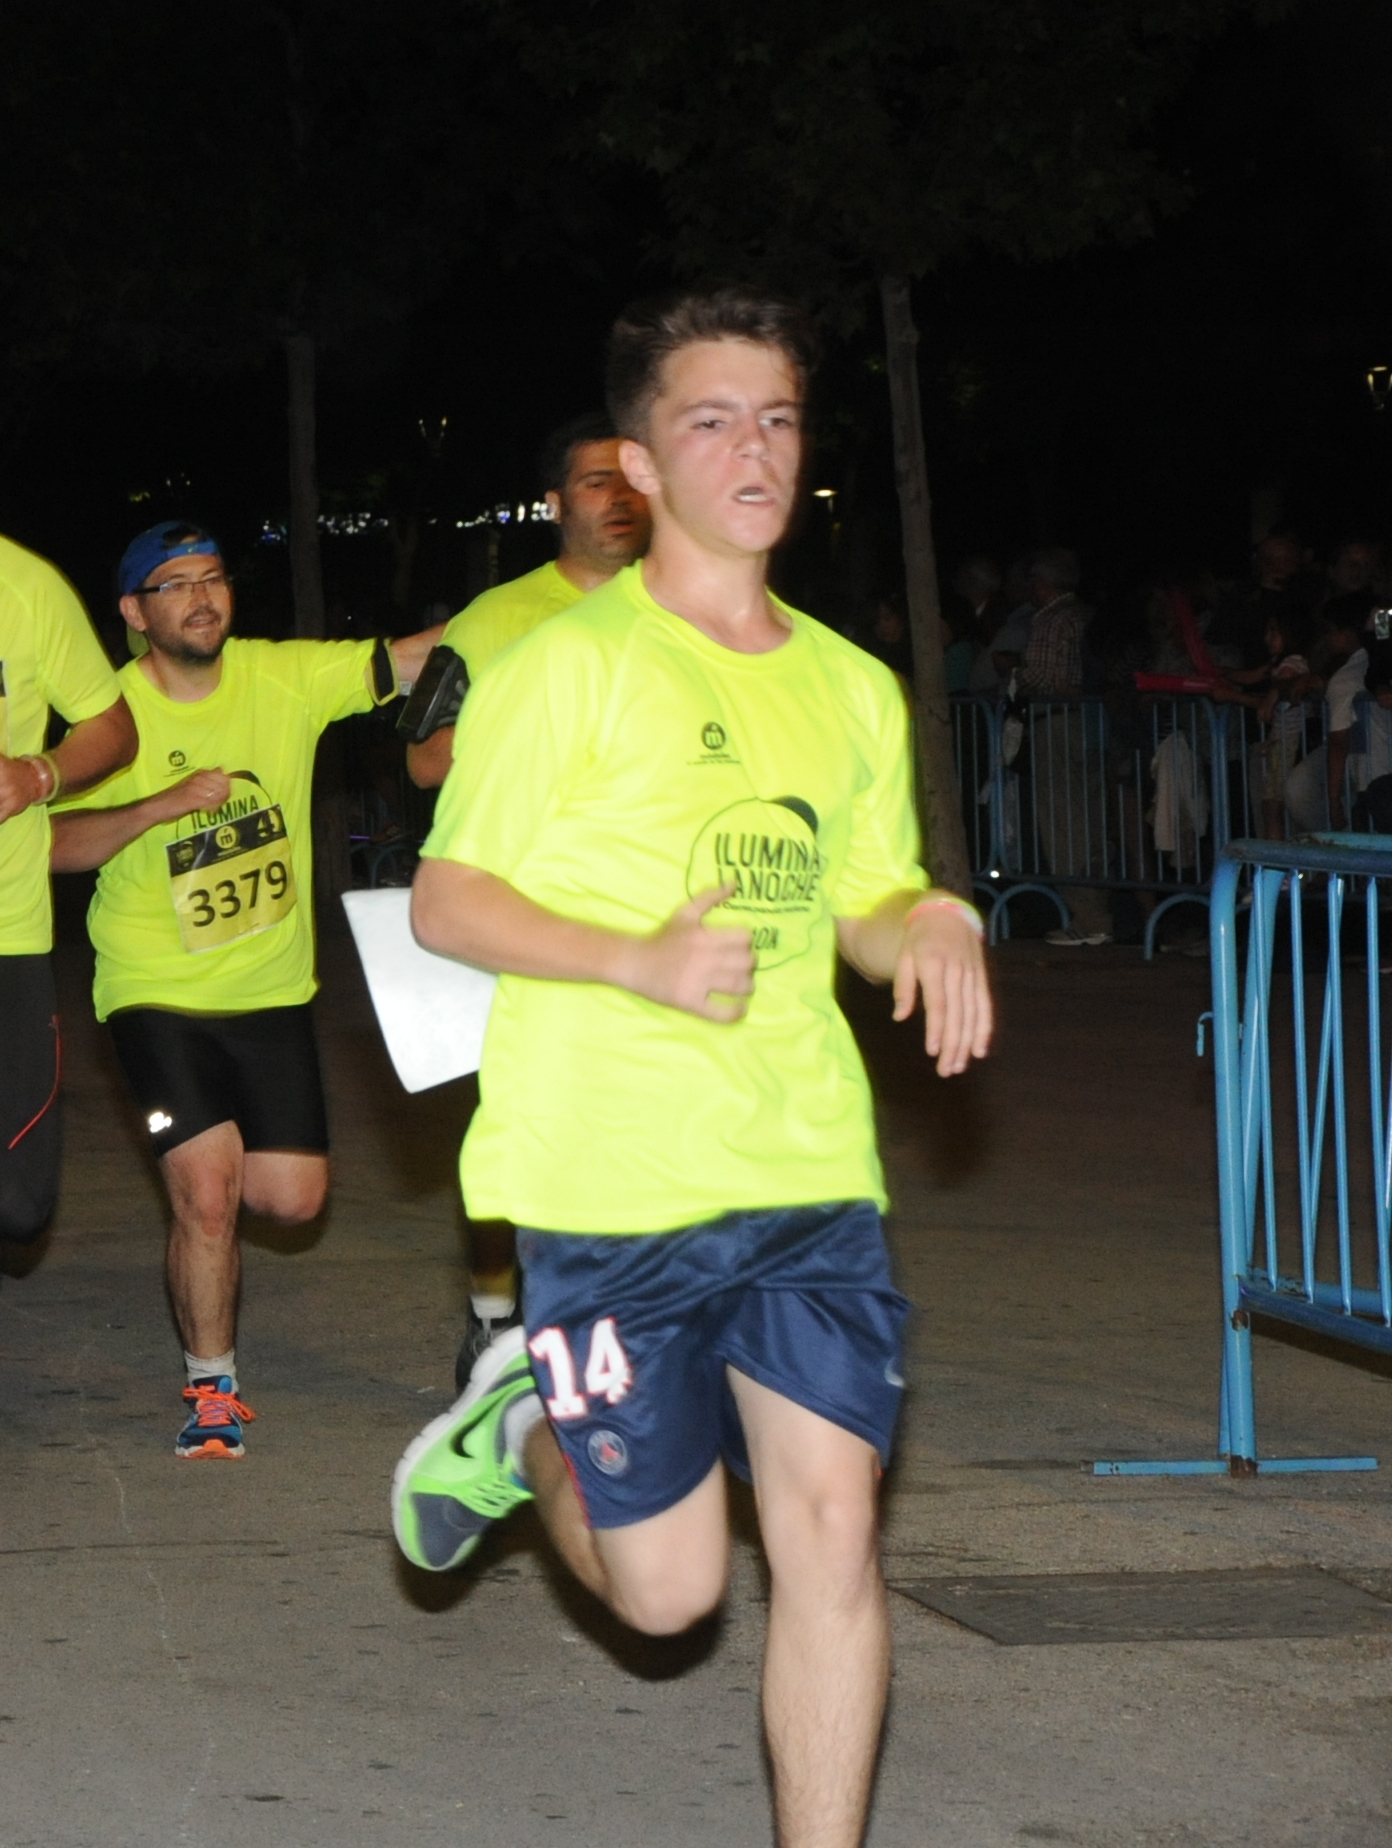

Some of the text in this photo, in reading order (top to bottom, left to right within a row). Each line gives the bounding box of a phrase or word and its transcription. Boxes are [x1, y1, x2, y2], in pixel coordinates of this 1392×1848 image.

[714, 832, 820, 871] ILUMINA
[188, 860, 288, 927] 3379
[527, 1316, 632, 1421] 14
